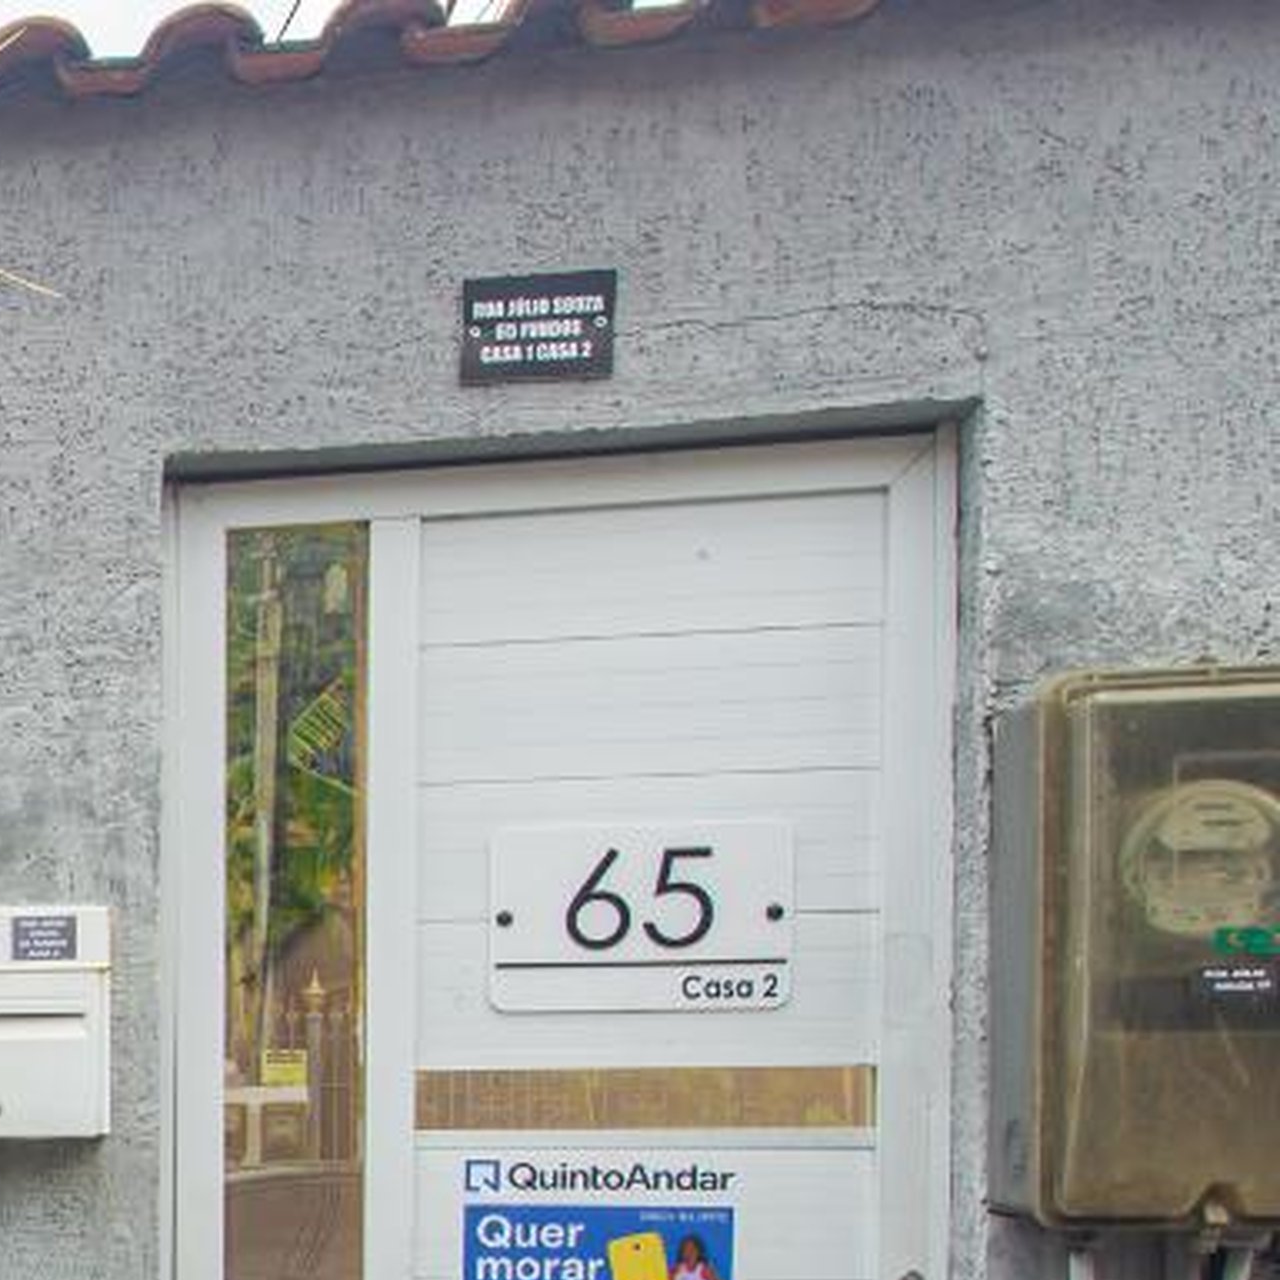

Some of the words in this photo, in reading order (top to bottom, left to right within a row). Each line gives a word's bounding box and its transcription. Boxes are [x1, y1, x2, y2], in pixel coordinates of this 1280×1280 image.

[480, 346, 523, 363] CASA
[526, 344, 535, 360] 1
[536, 342, 580, 361] CASA
[581, 340, 593, 358] 2
[566, 847, 715, 951] 65
[681, 974, 754, 999] Casa
[762, 973, 779, 998] 2
[508, 1162, 737, 1191] QuintoAndar
[476, 1214, 585, 1249] Quer
